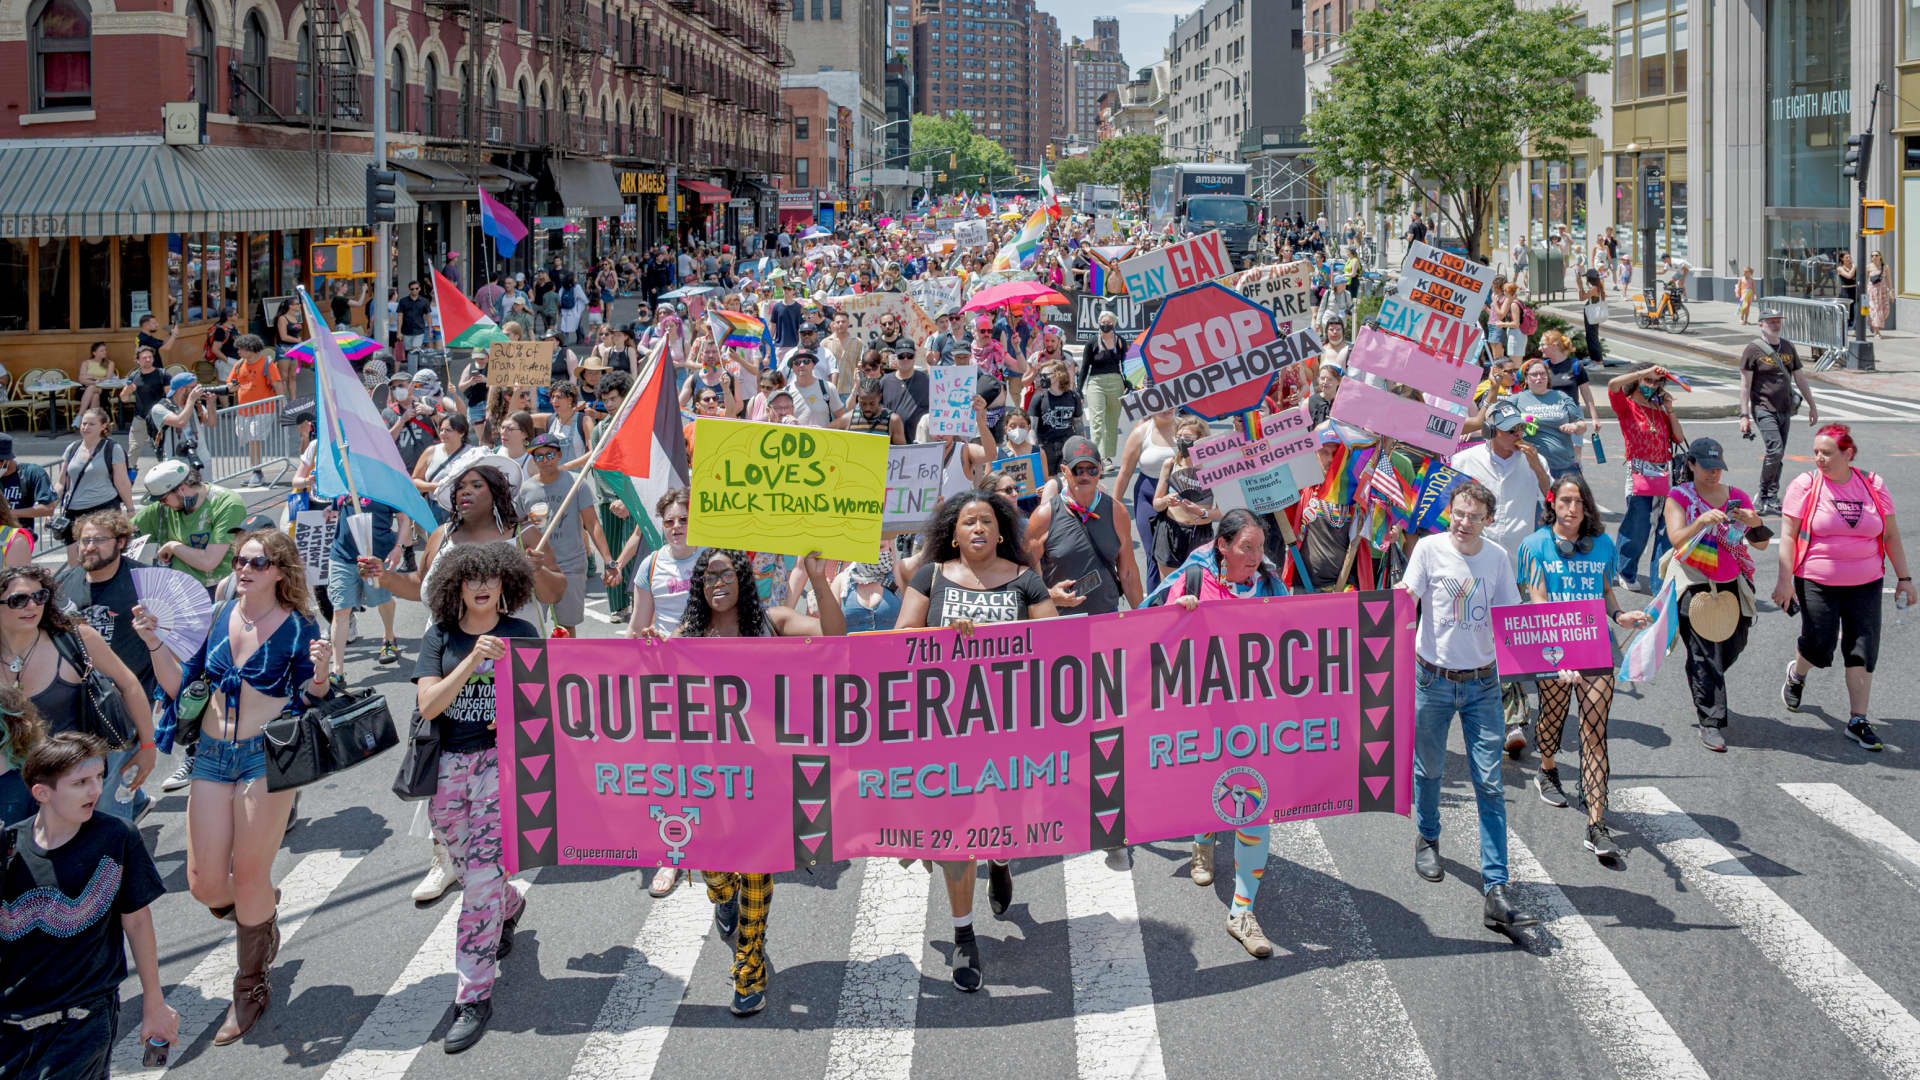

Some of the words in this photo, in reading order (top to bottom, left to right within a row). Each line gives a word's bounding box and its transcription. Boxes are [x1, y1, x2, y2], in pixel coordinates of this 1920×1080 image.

[1772, 97, 1783, 120] 111
[1786, 92, 1818, 119] EIGHTH
[620, 172, 637, 193] ARK
[638, 172, 665, 194] BAGELS
[1195, 175, 1233, 185] amazon
[20, 217, 67, 234] FREDA
[1125, 266, 1167, 303] SAY
[1166, 232, 1226, 289] GAY
[1428, 248, 1480, 275] KNOW
[1413, 256, 1483, 294] JUSTICE
[1243, 283, 1261, 298] OFF
[1266, 278, 1291, 293] OUR
[1416, 278, 1468, 305] KNOW
[1117, 297, 1141, 329] UP
[1409, 288, 1465, 319] PEACE
[1054, 312, 1072, 322] BACK
[1148, 310, 1263, 375] STOP
[1378, 299, 1423, 337] SAY
[1419, 312, 1481, 367] GAY
[936, 376, 974, 394] NICE
[1121, 331, 1323, 421] HOMOPHOBIA
[932, 408, 975, 420] TRANS
[933, 421, 975, 433] PEOPLE
[1196, 437, 1247, 459] EQUAL
[1251, 415, 1304, 442] GHTS
[1428, 416, 1443, 431] ACT
[1444, 421, 1457, 436] UP
[760, 429, 816, 463] GOD
[1245, 443, 1267, 456] are
[918, 463, 939, 480] FOR
[1202, 459, 1256, 485] HUMAN
[1260, 437, 1314, 466] RIGHTS
[725, 460, 826, 489] LOVES
[1259, 474, 1273, 483] not
[1248, 480, 1282, 493] moment,
[700, 491, 764, 513] BLACK
[763, 492, 830, 513] TRANS
[296, 523, 311, 564] ABOLIT
[309, 526, 322, 567] WITHOUT
[1543, 561, 1564, 573] WE
[1562, 576, 1576, 589] TO
[1581, 577, 1594, 589] BE
[947, 589, 1015, 606] BLACK
[945, 603, 1016, 621] TRANS
[1504, 611, 1582, 630] HEALTHCARE
[1585, 615, 1594, 625] IS
[906, 635, 941, 664] 7th
[952, 627, 1033, 661] Annual
[1504, 636, 1512, 647] A
[1513, 630, 1558, 646] HUMAN
[1562, 626, 1598, 642] RIGHT
[459, 684, 475, 697] EW
[556, 673, 754, 743] QUEER
[774, 648, 1127, 748] LIBERATION
[1150, 626, 1354, 712] MARCH
[1148, 717, 1340, 769] REJOICE!
[594, 762, 755, 799] RESIST!
[858, 750, 1070, 799] RECLAIM!
[1273, 798, 1354, 821] queermarch.org
[875, 827, 924, 849] JUNE
[931, 828, 960, 852] 29,
[966, 822, 1018, 850] 2025,
[1026, 820, 1064, 844] NYC
[562, 844, 639, 862] @queermarch
